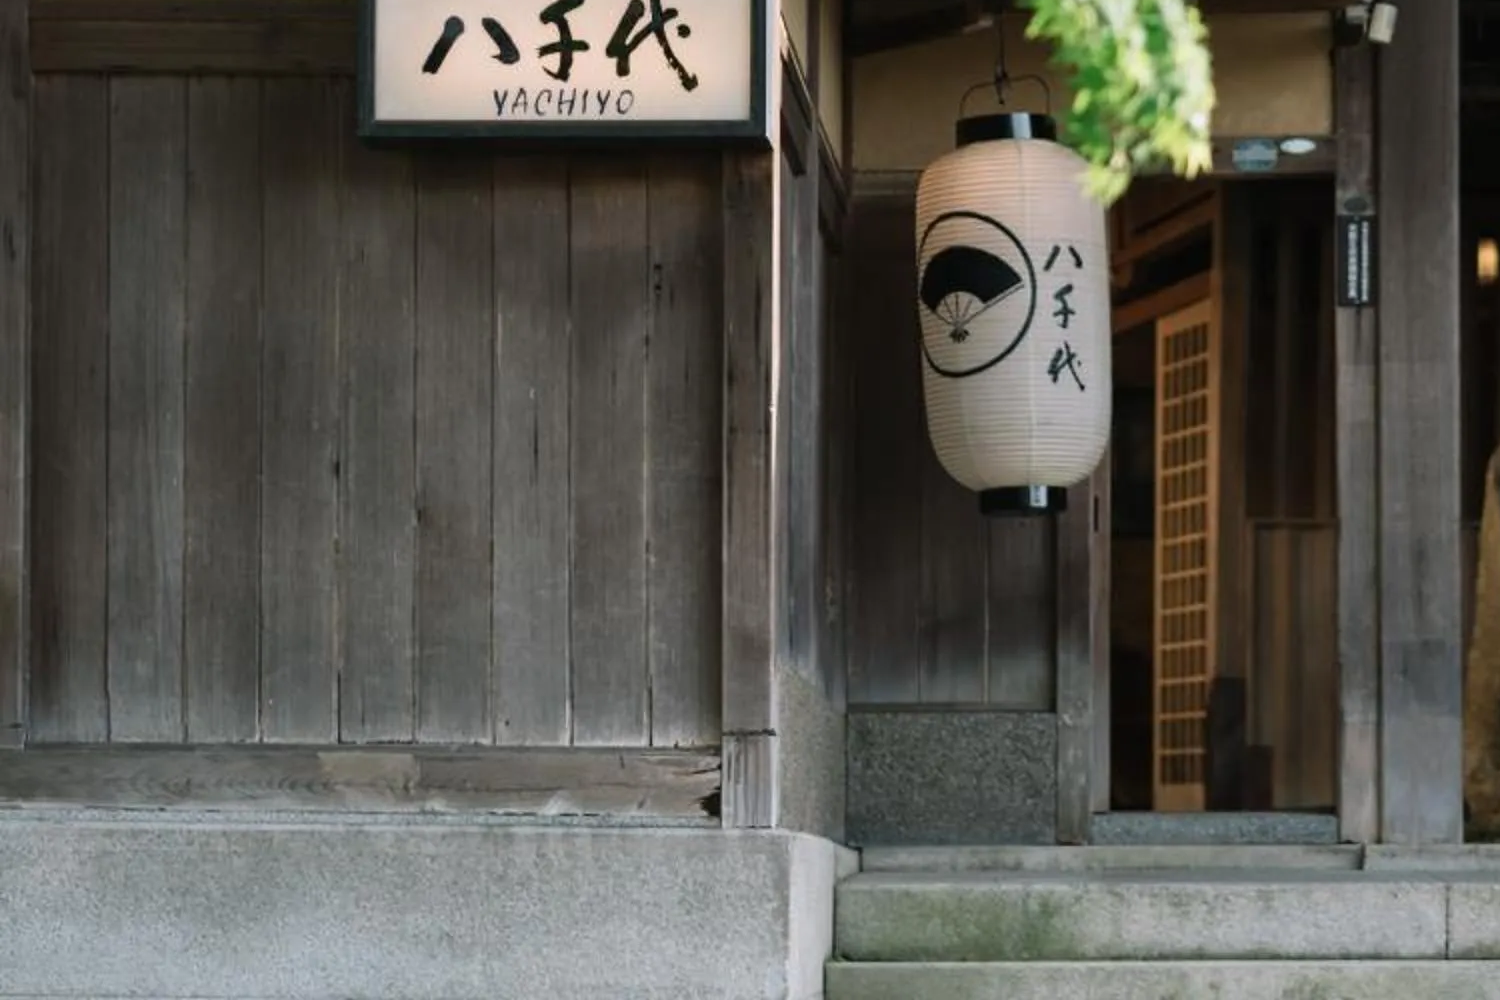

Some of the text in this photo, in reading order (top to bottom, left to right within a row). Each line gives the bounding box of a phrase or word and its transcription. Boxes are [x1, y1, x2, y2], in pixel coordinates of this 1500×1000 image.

[493, 88, 636, 117] YACHIYO
[1043, 244, 1086, 392] 八千代
